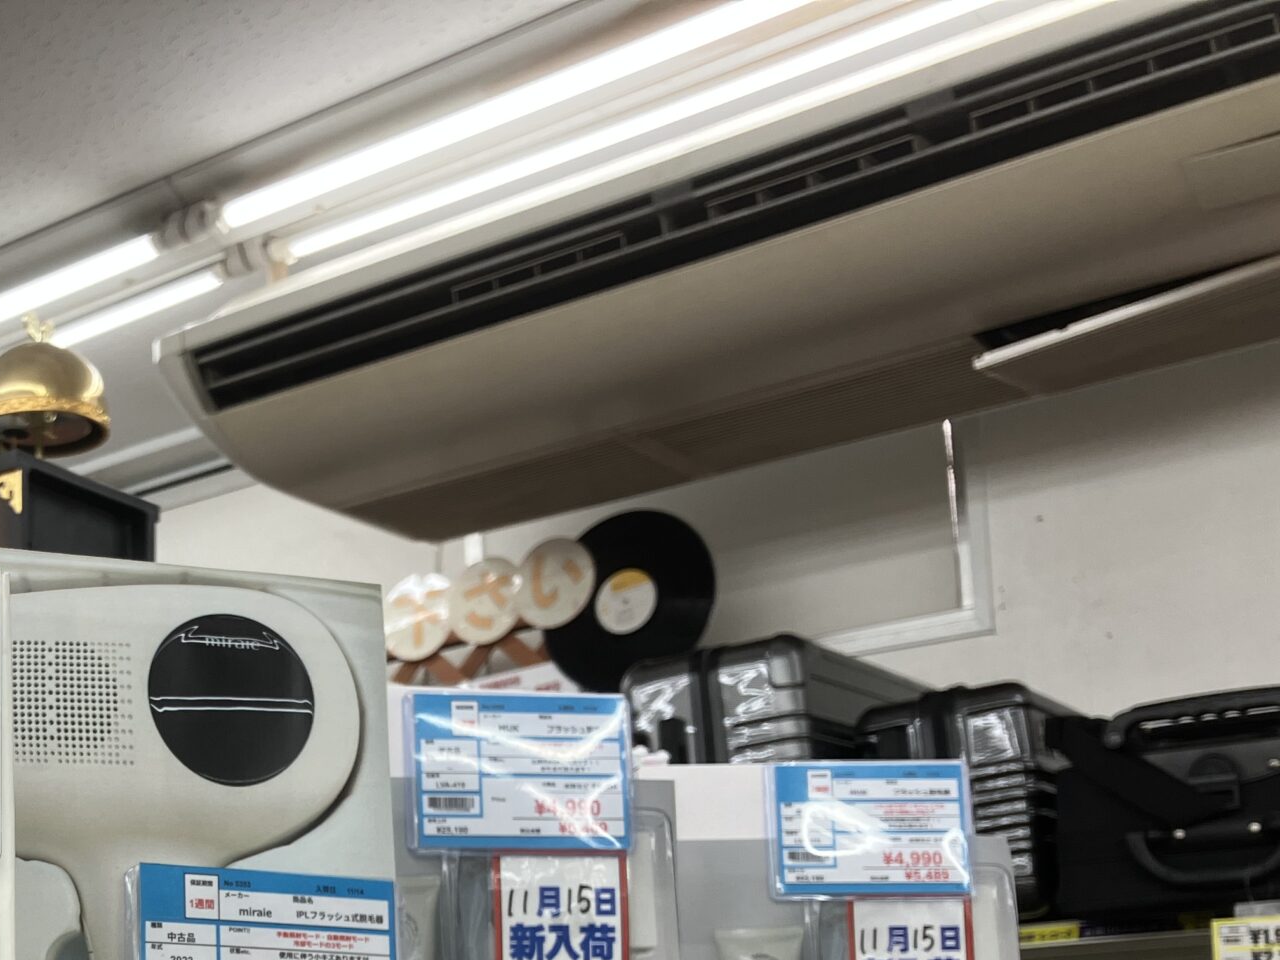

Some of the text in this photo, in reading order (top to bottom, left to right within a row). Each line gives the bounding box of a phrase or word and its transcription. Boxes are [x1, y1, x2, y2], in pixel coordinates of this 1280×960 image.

[882, 850, 944, 869] ¥4,990
[189, 898, 215, 910] 1週間
[508, 884, 617, 918] 11月15日
[238, 906, 273, 918] miraie
[167, 931, 196, 943] 中古品
[860, 924, 962, 955] 11月15日
